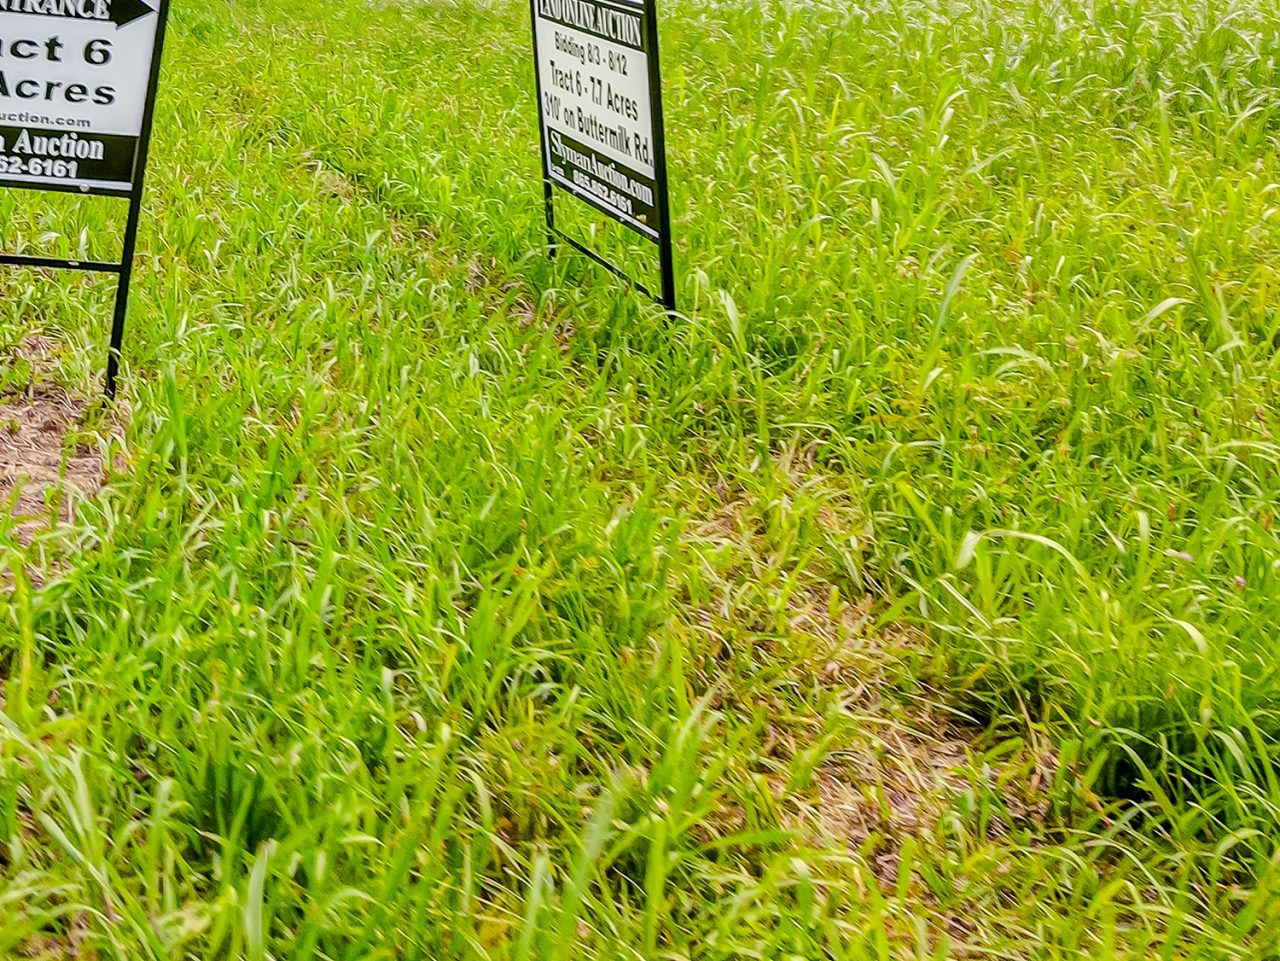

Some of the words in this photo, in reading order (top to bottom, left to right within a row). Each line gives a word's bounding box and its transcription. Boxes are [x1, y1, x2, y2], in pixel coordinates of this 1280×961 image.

[554, 30, 585, 65] Bidding
[596, 5, 642, 48] AUCTION
[83, 38, 113, 66] 6
[549, 59, 575, 94] Tract
[575, 70, 582, 97] 6
[590, 75, 602, 106] 7.7
[606, 82, 639, 122] Acres
[12, 128, 105, 161] Auction
[564, 107, 576, 130] on
[577, 106, 632, 157] Buttermilk
[550, 129, 655, 208] SlymanAuction.com
